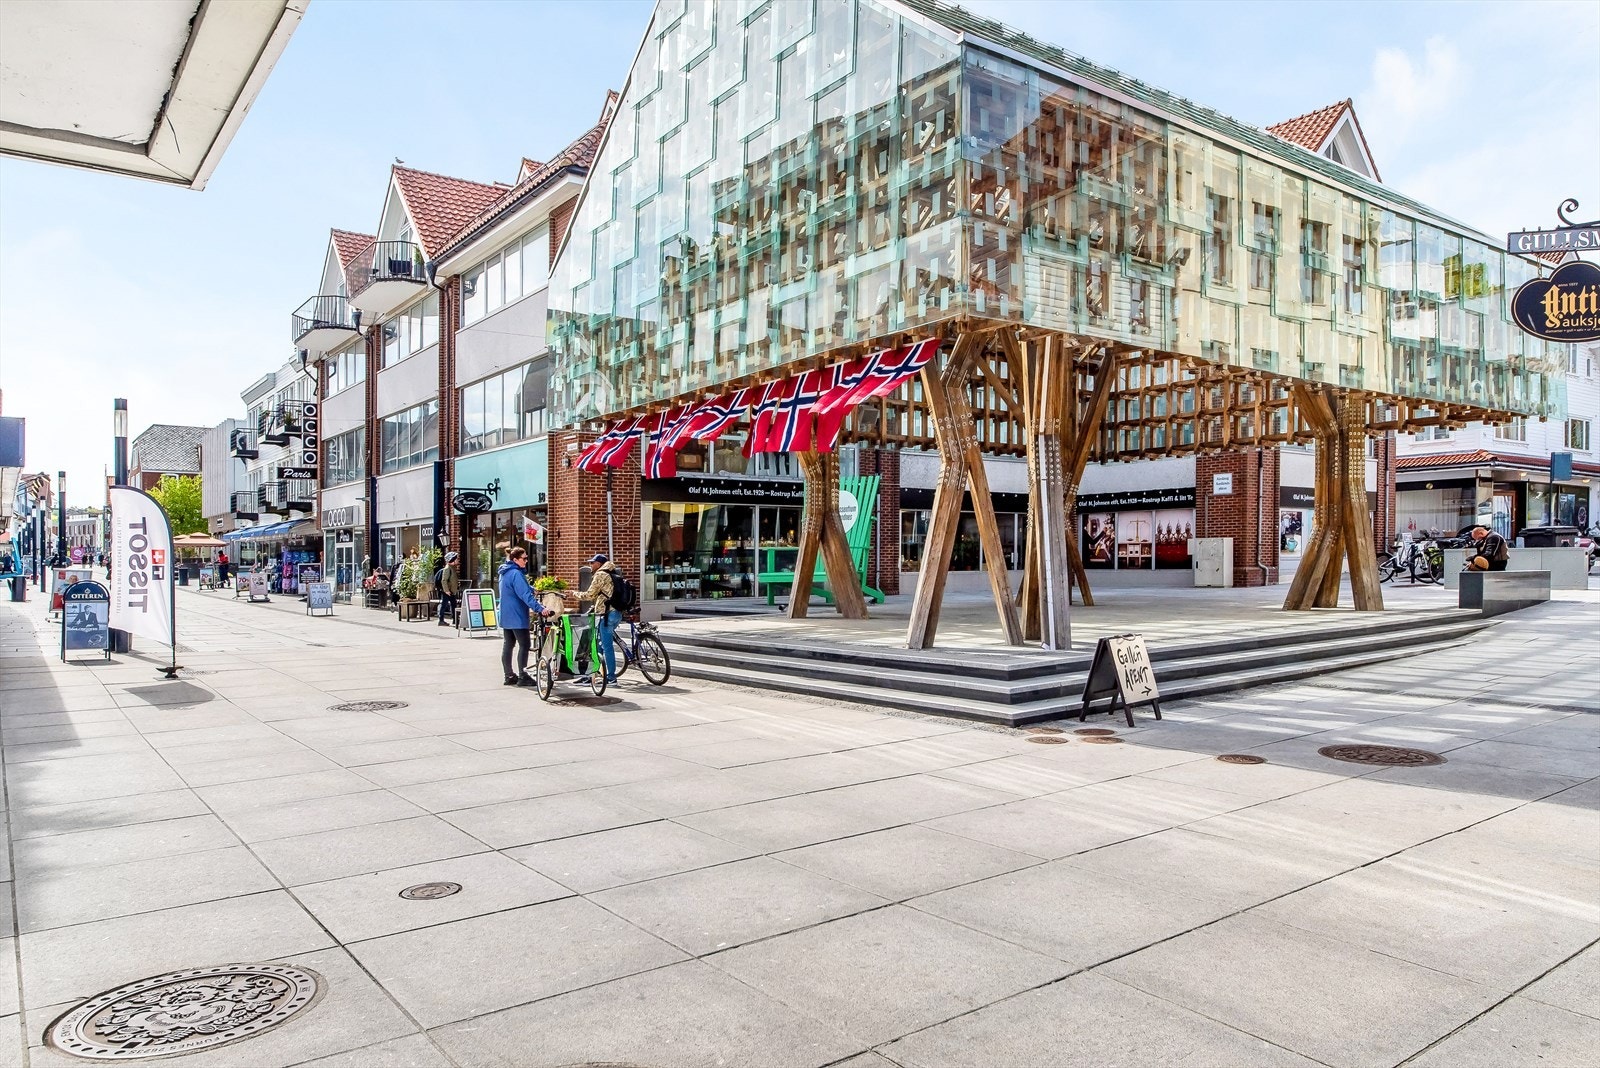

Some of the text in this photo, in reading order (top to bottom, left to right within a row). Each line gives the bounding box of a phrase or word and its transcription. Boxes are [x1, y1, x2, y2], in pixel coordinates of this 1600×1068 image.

[1539, 284, 1600, 317] Anti
[283, 468, 311, 478] Paris
[688, 486, 701, 494] Olaf
[770, 490, 790, 499] Rostrup
